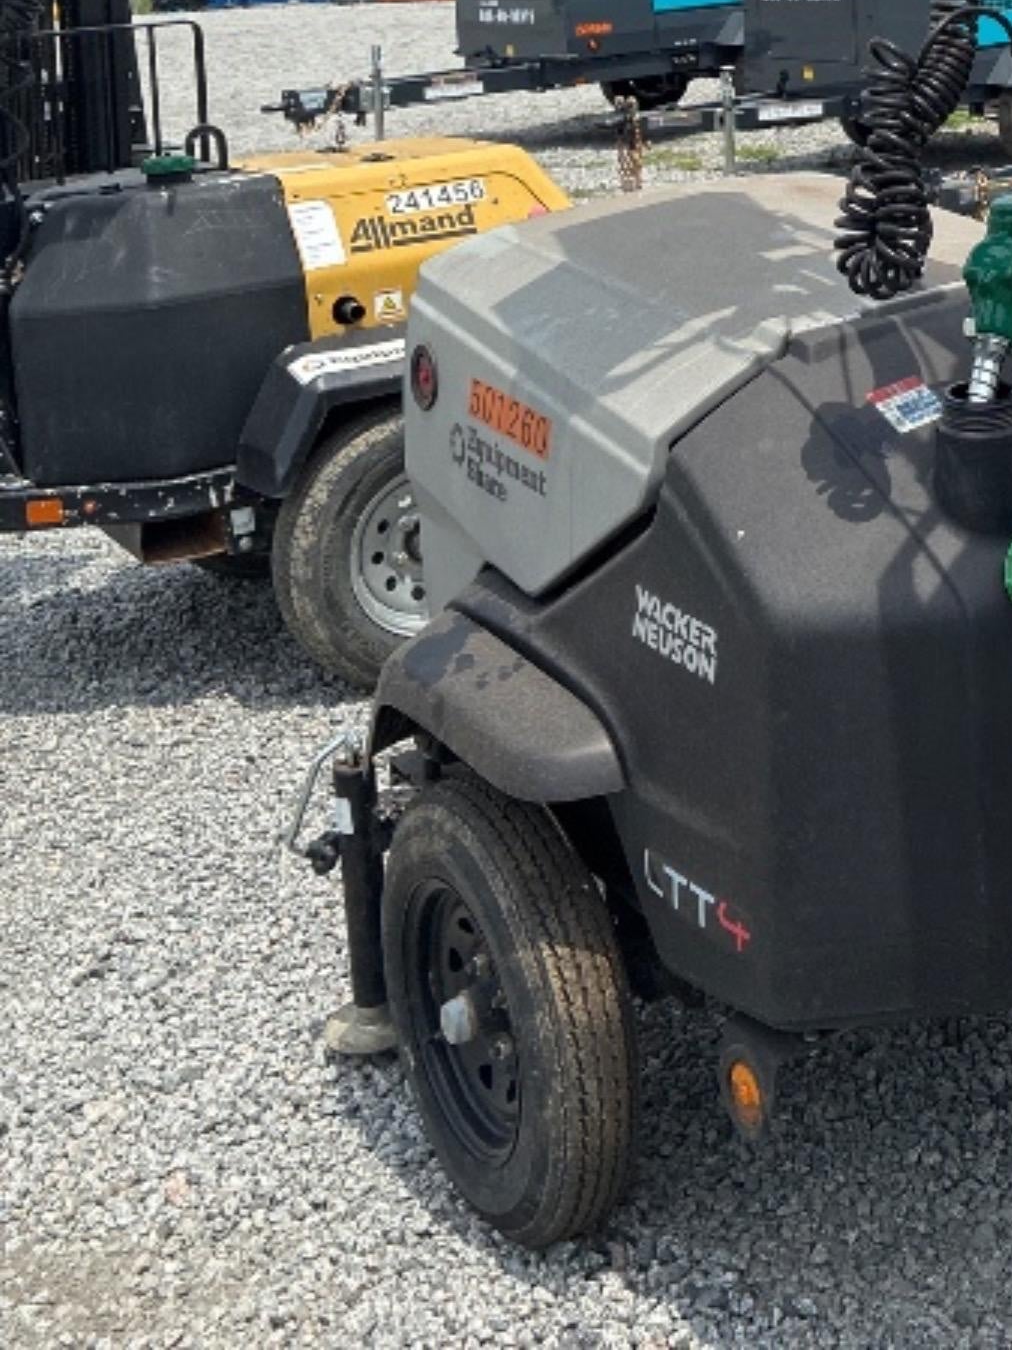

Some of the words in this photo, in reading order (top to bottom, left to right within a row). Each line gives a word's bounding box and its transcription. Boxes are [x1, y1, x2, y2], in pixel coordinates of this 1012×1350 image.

[350, 203, 475, 249] Allmand
[387, 179, 484, 213] 241456
[468, 378, 549, 457] 501260
[632, 613, 716, 685] NEUSON
[634, 584, 718, 655] WACKER
[643, 848, 749, 951] LTT4
